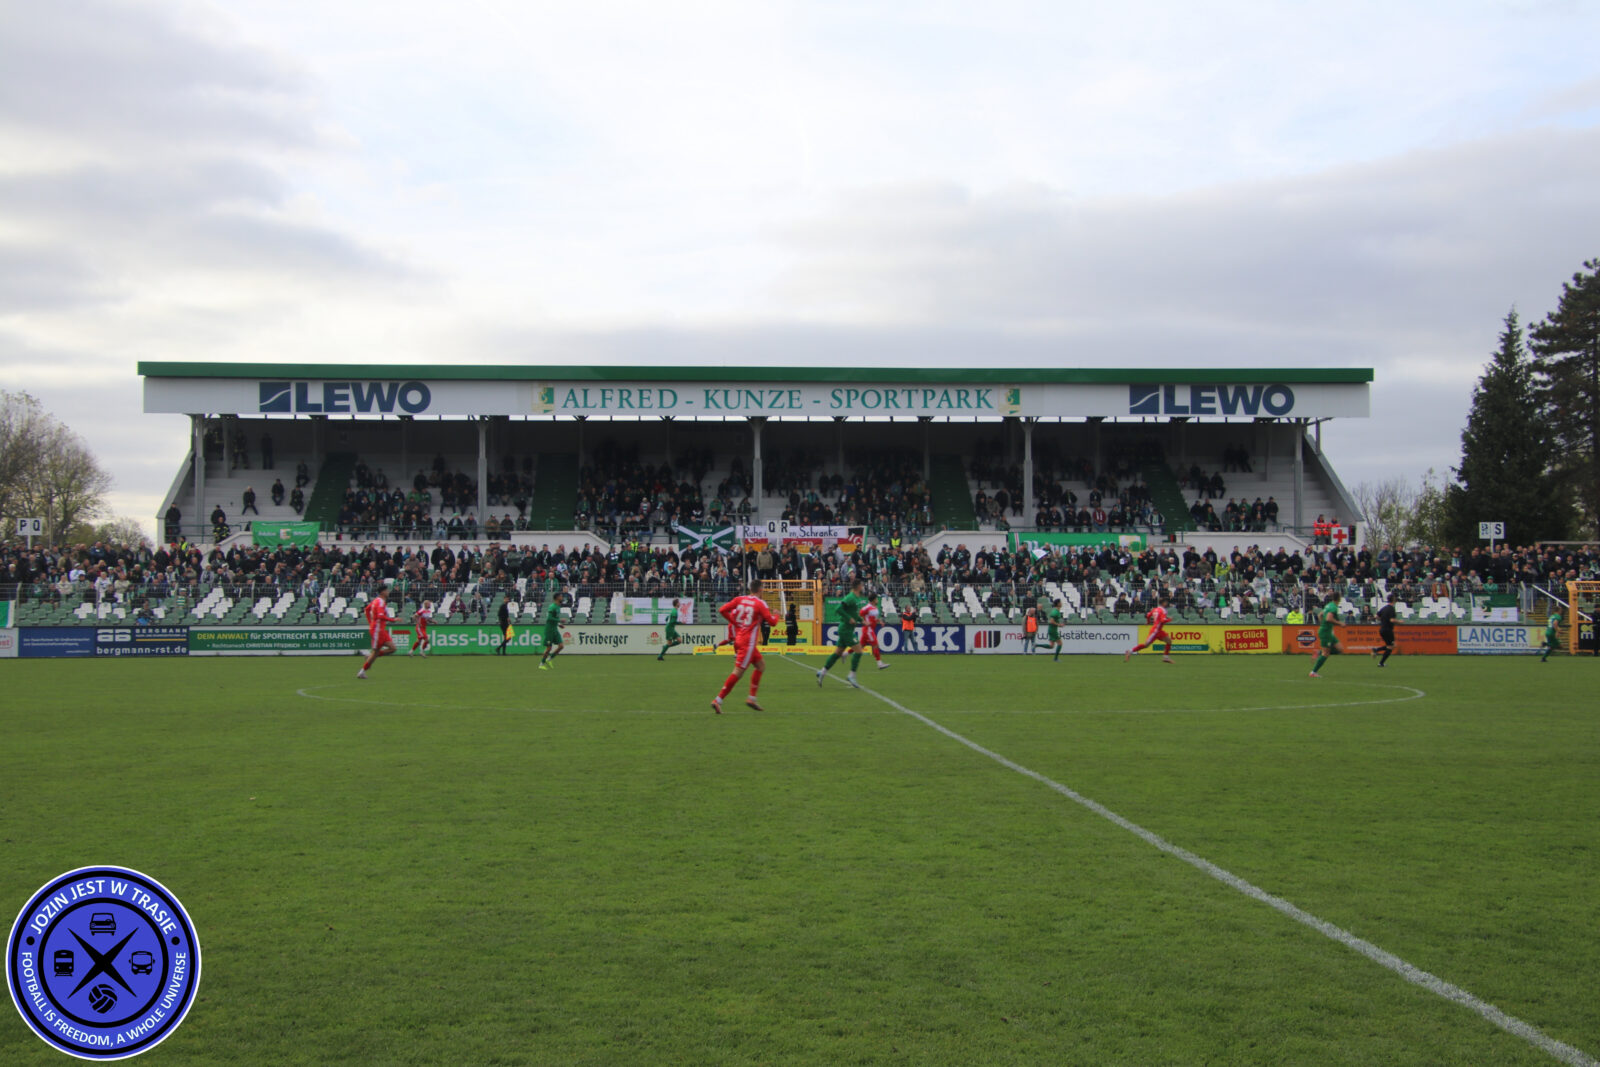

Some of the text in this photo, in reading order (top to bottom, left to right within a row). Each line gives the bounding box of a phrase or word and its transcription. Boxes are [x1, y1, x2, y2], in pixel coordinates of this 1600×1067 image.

[295, 382, 431, 414] LEWO
[562, 389, 678, 410] ALFRED
[703, 389, 802, 410] KUNZE
[829, 389, 994, 410] SPORTPARK
[1163, 384, 1296, 416] LEWO
[20, 520, 27, 531] P
[781, 521, 788, 533] R
[1495, 523, 1502, 535] S
[736, 603, 753, 625] 23
[250, 632, 261, 640] für
[262, 632, 309, 640] SPORTRECHT
[311, 632, 317, 640] &
[319, 632, 365, 640] STRAFRECHT
[578, 632, 628, 649] Freiberger
[1170, 632, 1202, 641] LOTTO
[1226, 630, 1264, 640] Das Glück
[1458, 627, 1527, 643] LANGER
[1227, 641, 1237, 649] ist
[1250, 640, 1267, 648] nah.
[96, 646, 187, 656] bergmann-rst.de
